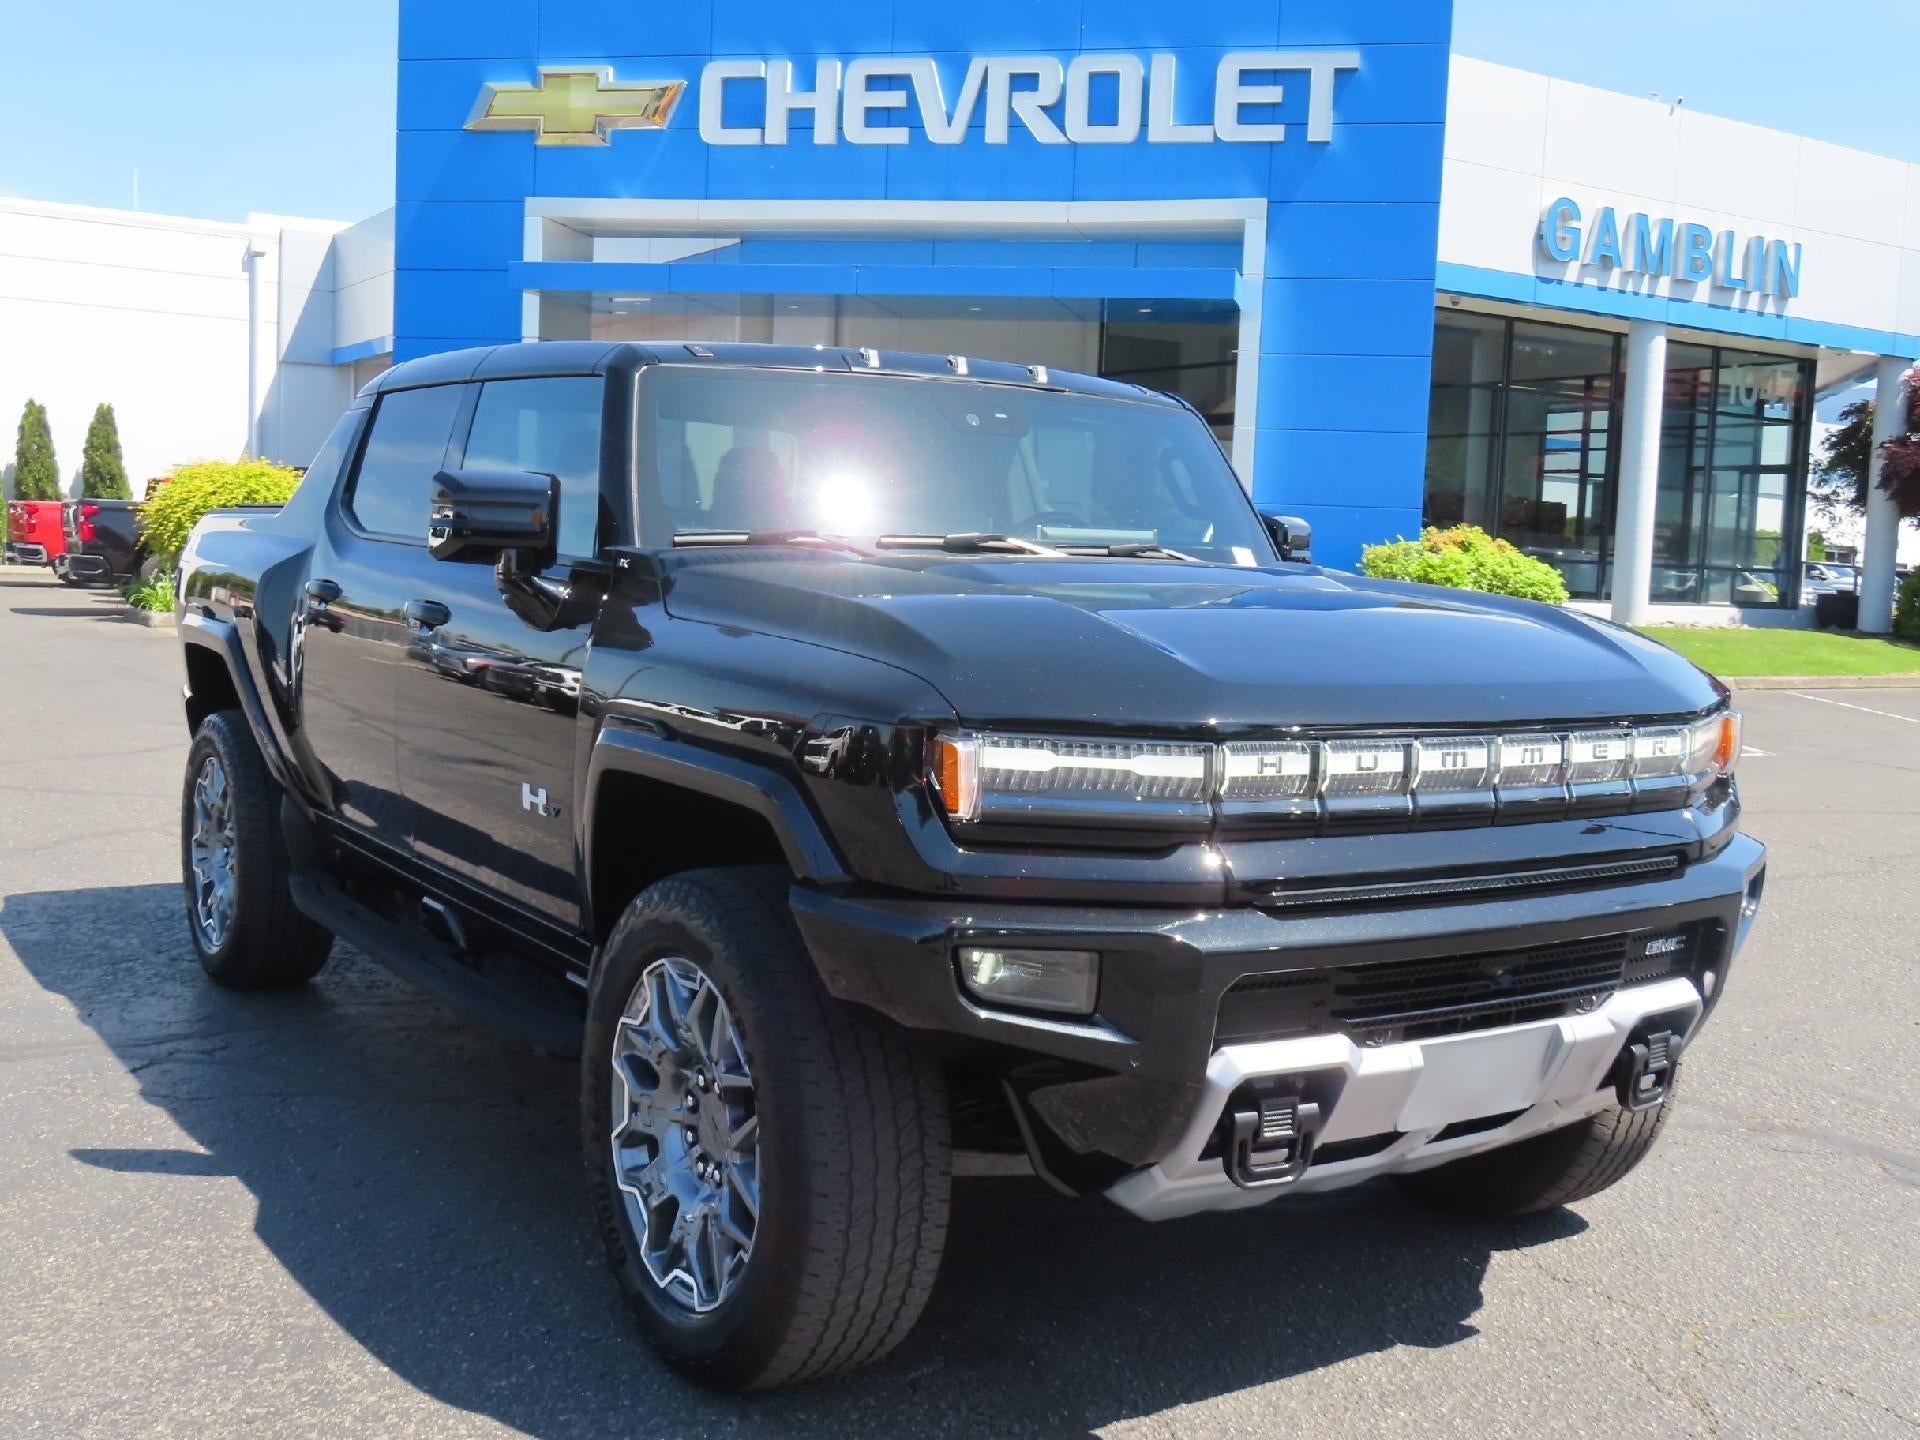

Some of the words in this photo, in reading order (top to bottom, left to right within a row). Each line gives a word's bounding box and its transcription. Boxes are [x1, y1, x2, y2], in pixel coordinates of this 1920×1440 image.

[699, 52, 1361, 146] CHEVROLET
[1537, 197, 1802, 299] GAMBLIN
[1257, 739, 1666, 774] HUMMER
[1645, 935, 1687, 955] GMC
